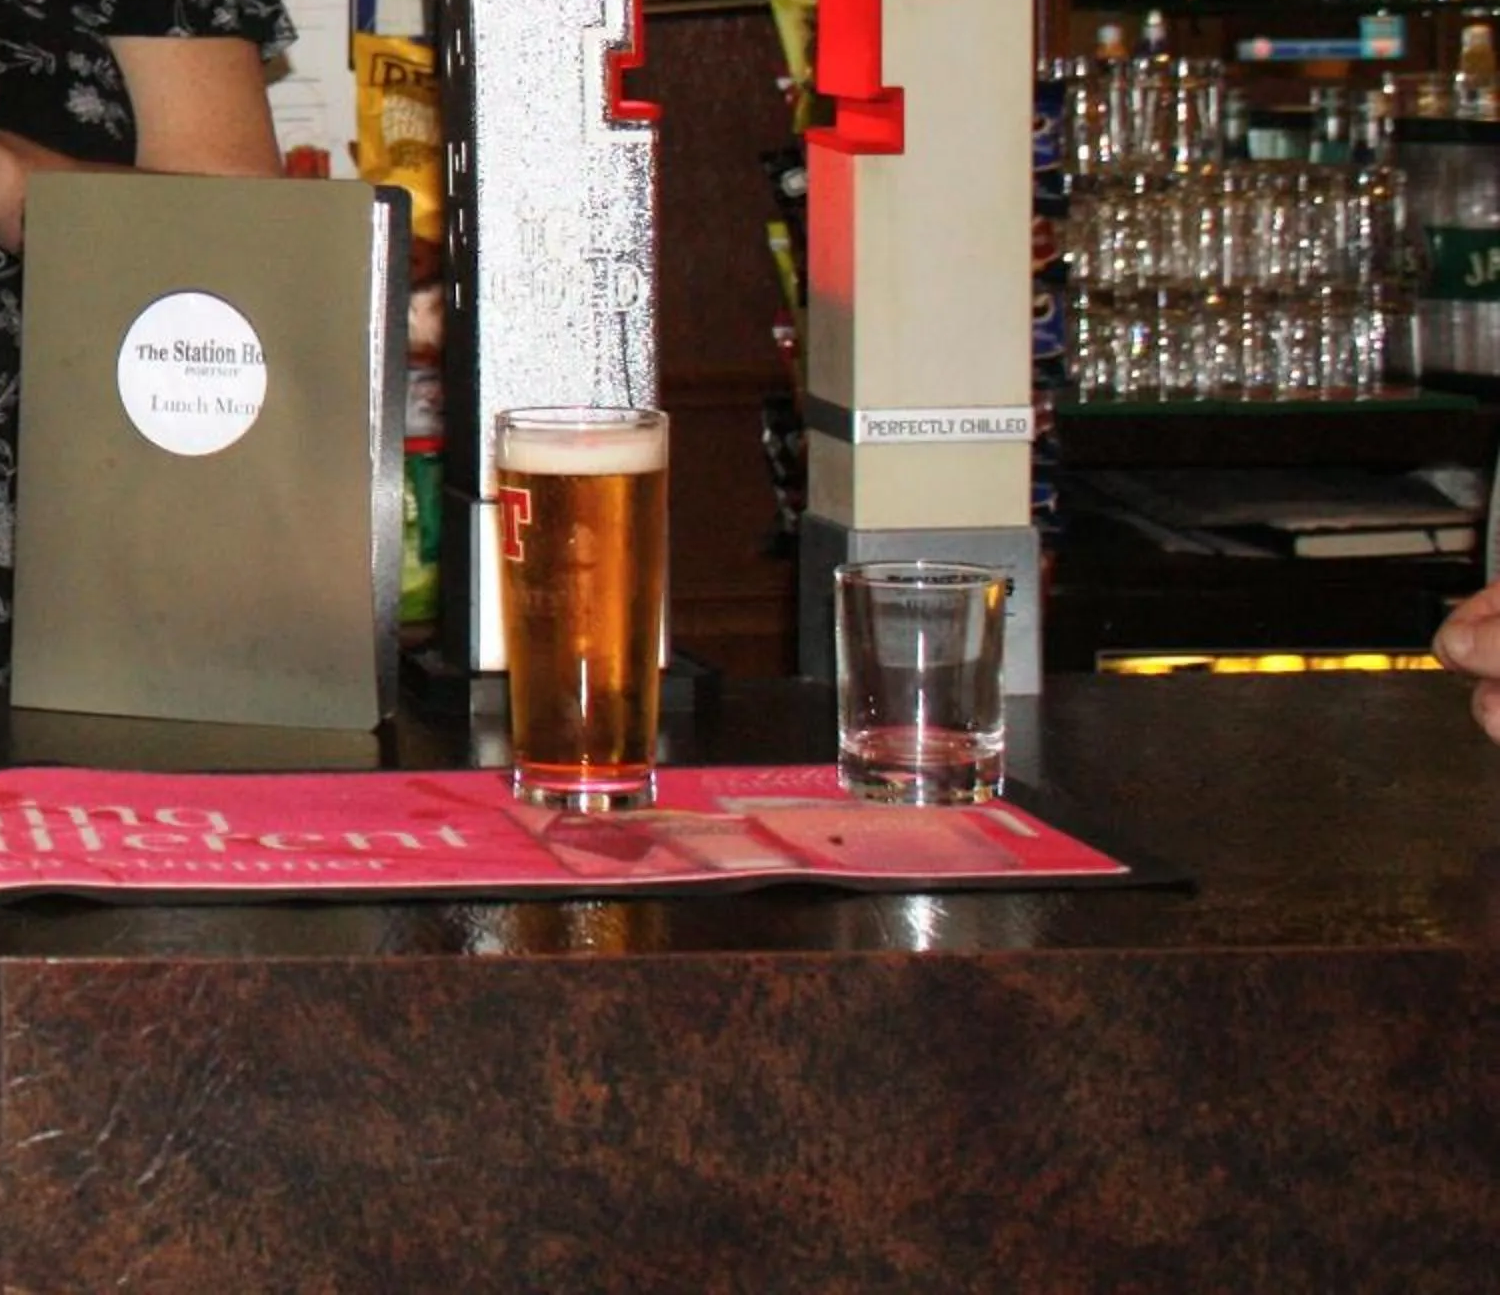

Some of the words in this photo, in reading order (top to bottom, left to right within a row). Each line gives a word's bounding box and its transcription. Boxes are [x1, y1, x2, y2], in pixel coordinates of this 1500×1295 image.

[136, 343, 168, 363] The
[173, 339, 236, 365] Station
[151, 395, 209, 415] Lunch
[867, 419, 955, 436] PERFECTLY
[960, 417, 1027, 434] CHILLED
